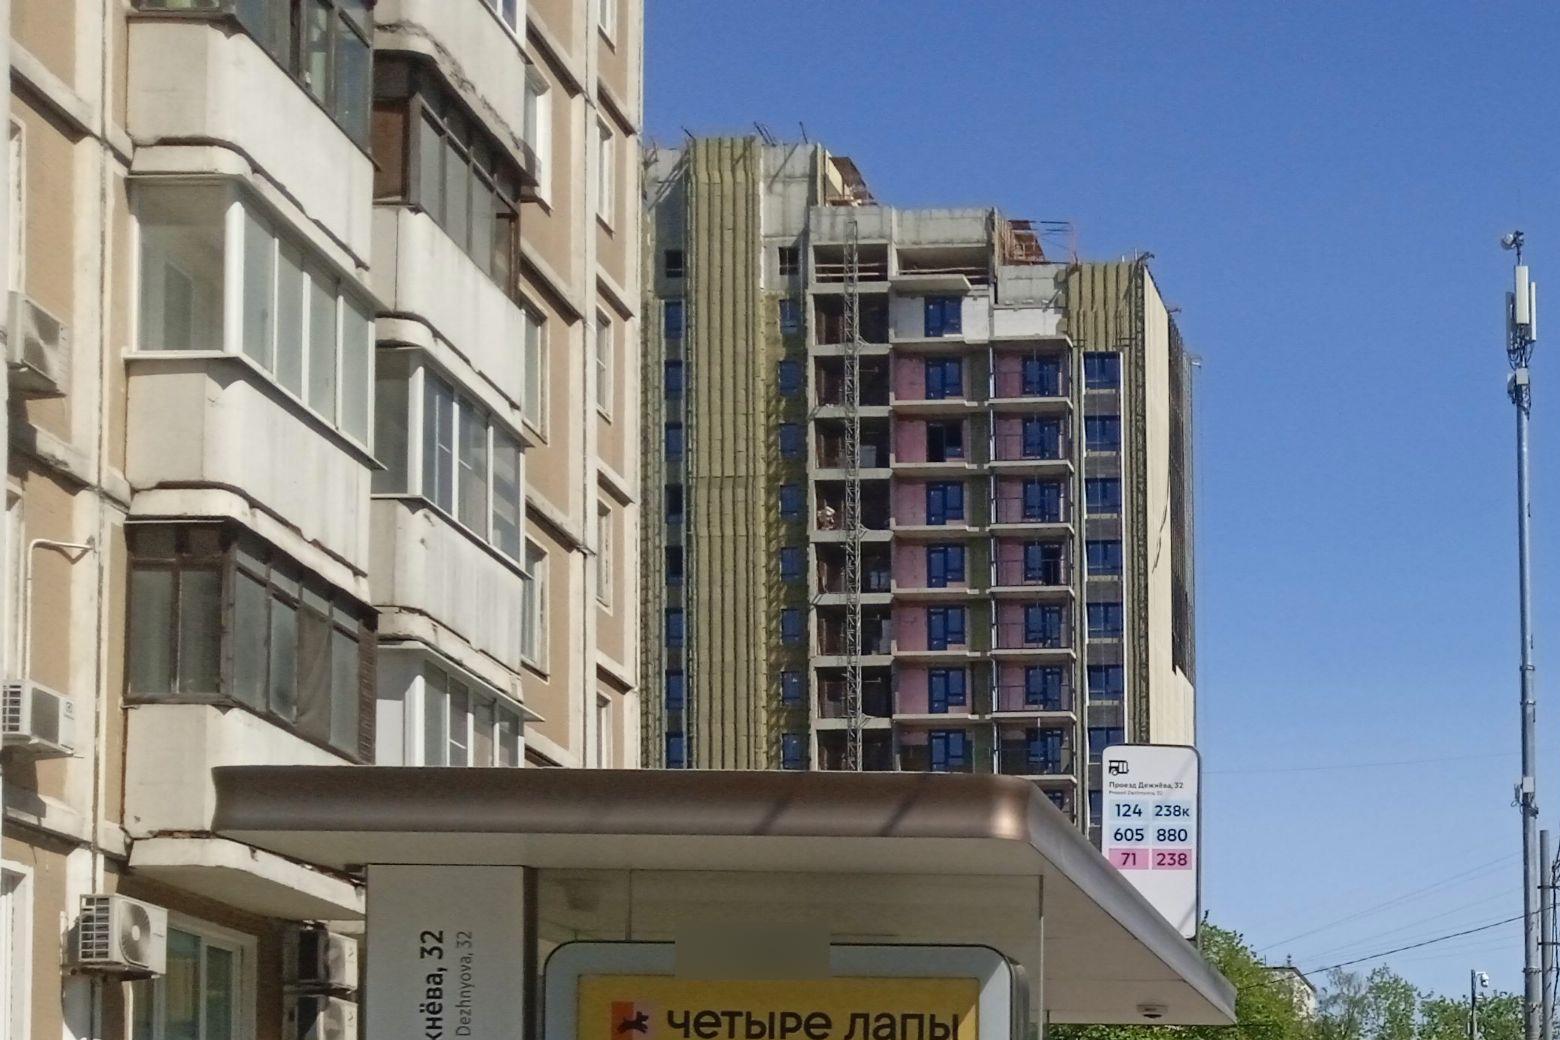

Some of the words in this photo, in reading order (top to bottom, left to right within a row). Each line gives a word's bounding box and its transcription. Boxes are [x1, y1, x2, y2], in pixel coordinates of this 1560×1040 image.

[1115, 804, 1142, 817] 124
[1155, 805, 1190, 817] 238к
[1113, 828, 1144, 841] 605
[1156, 828, 1188, 842] 880
[1121, 852, 1136, 866] 71
[1156, 852, 1188, 866] 238
[420, 930, 444, 960] 32
[456, 930, 473, 949] 32
[456, 952, 474, 1037] Dezhnyova,
[667, 1009, 832, 1040] четыре
